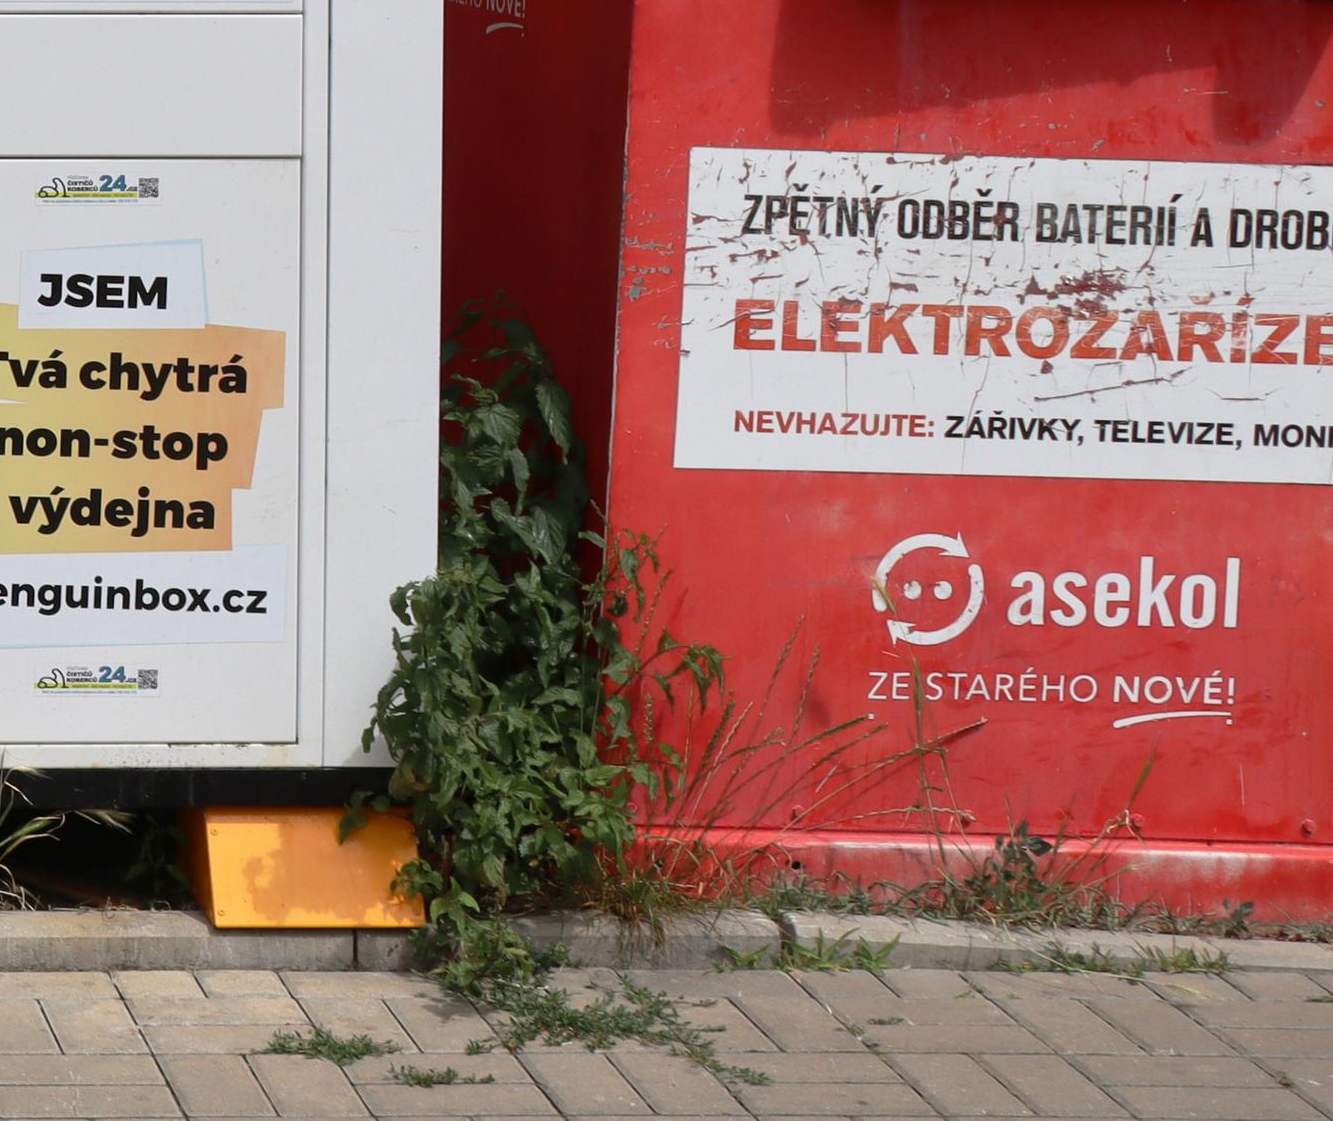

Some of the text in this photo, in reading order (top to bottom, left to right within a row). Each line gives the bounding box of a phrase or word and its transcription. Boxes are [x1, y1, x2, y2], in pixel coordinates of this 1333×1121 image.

[741, 183, 883, 240] ZPĚTNÝ
[897, 189, 1020, 244] ODBĚR
[1036, 193, 1181, 247] BATERIÍ
[1190, 207, 1214, 248] A
[37, 273, 168, 310] JSEM
[78, 352, 248, 401] chytrá
[733, 410, 935, 438] NEVHAZUJTE:
[944, 410, 1084, 447] ZÁŘIVKY,
[1096, 419, 1243, 451] TELEVIZE,
[8, 485, 215, 538] výdejna
[1007, 556, 1241, 629] asekol
[868, 667, 1235, 706] ZE STARÉHO NOVÉ!
